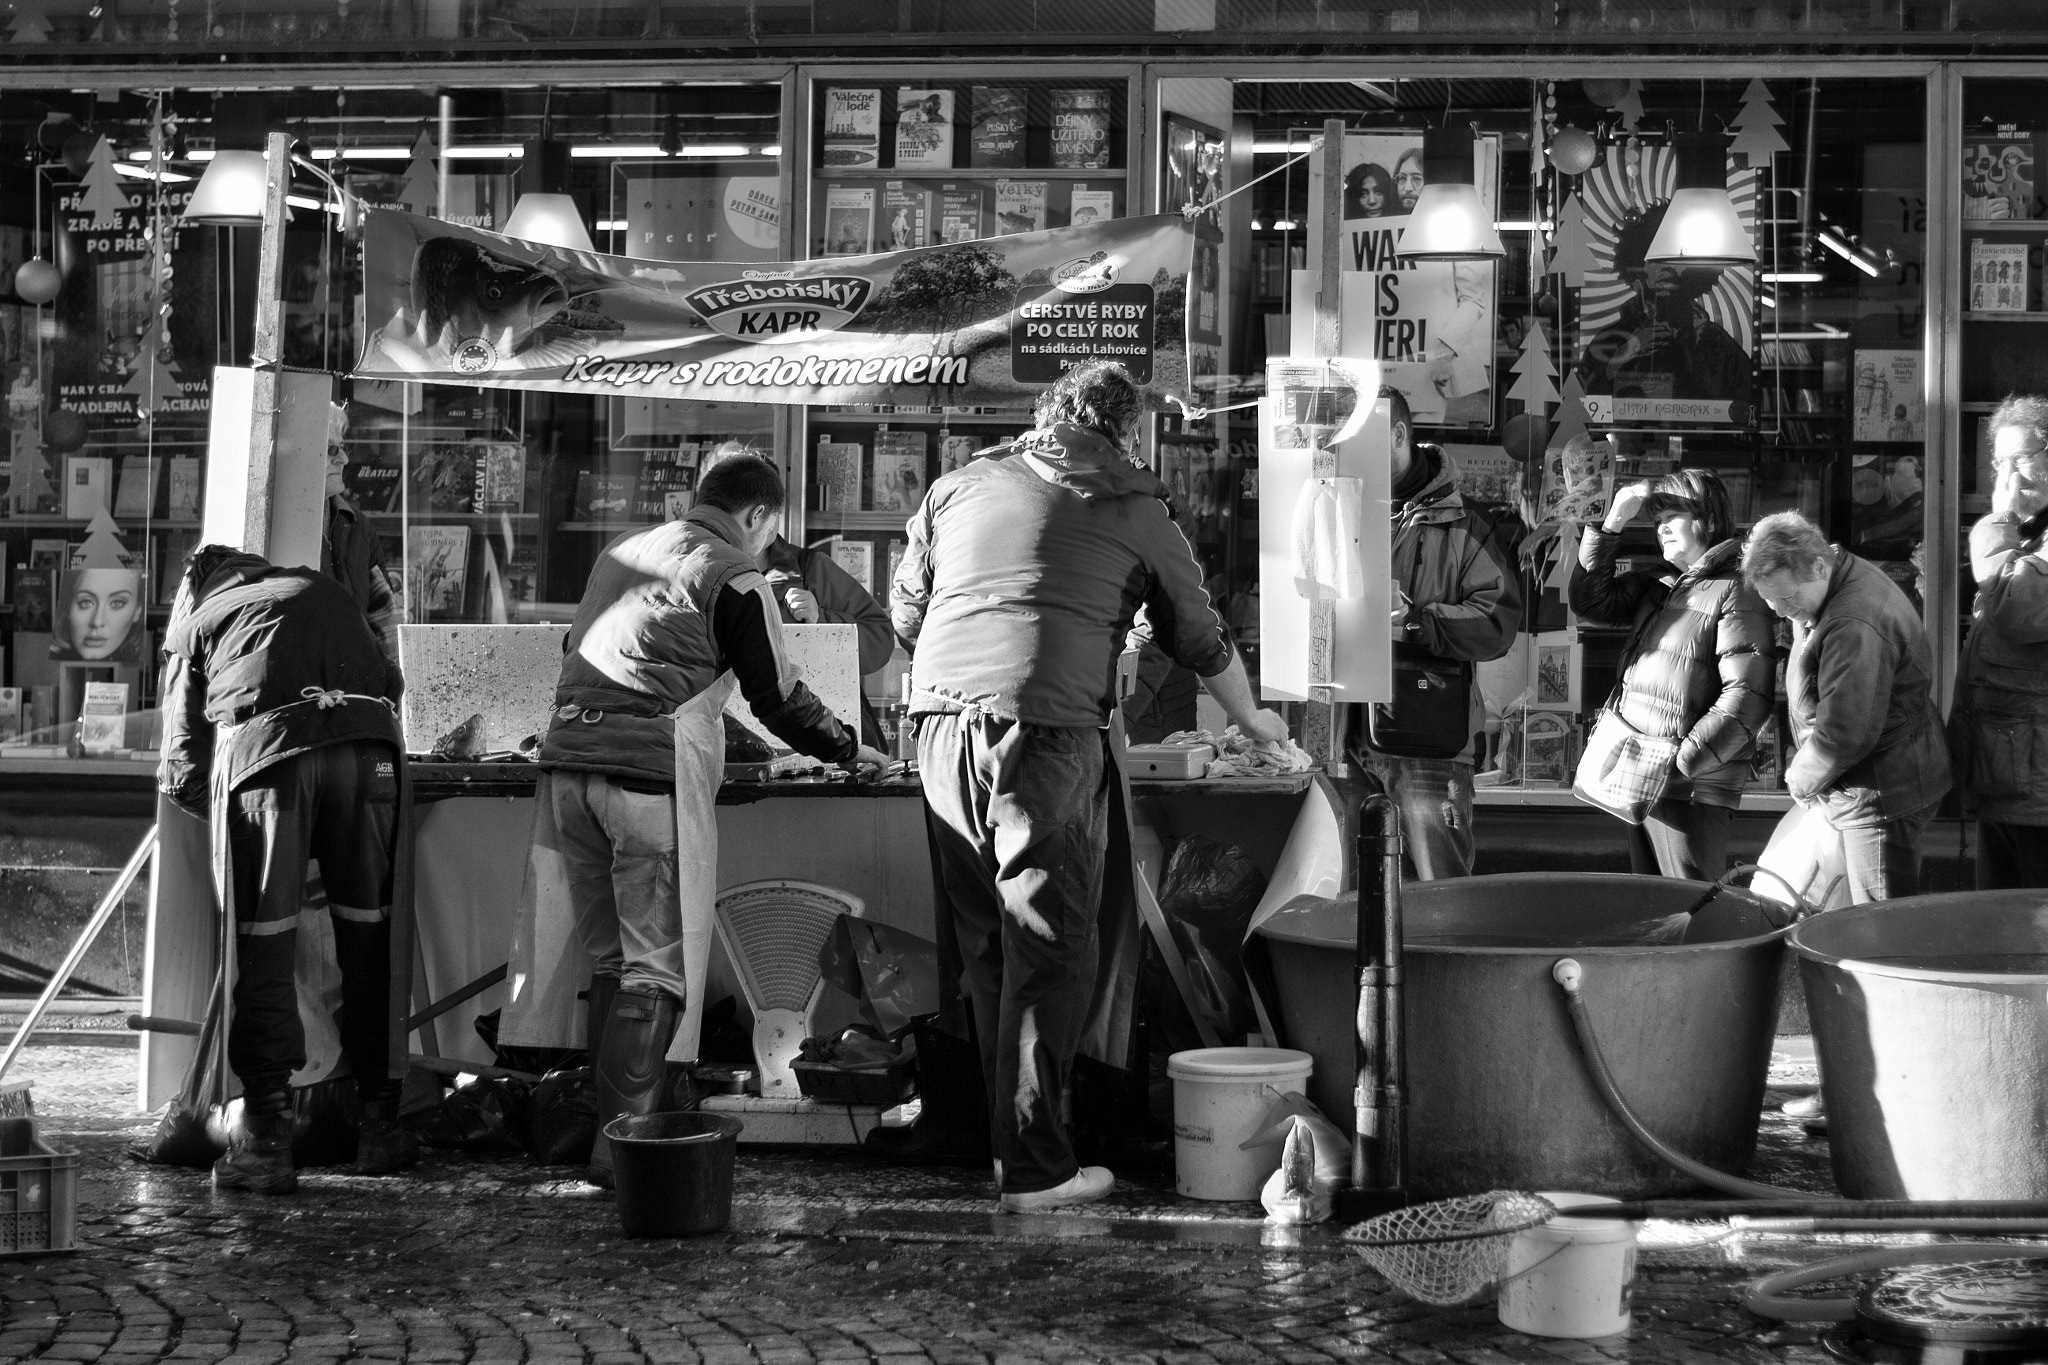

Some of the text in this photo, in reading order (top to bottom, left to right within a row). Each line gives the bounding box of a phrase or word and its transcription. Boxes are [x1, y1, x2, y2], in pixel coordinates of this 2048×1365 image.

[832, 91, 875, 102] Válečné
[846, 101, 871, 111] lodě
[148, 189, 193, 207] LÁSC
[997, 183, 1045, 198] Velký
[86, 238, 111, 253] PO
[693, 279, 861, 310] Třeboňský
[1019, 301, 1148, 320] ČERSTVÉ RYBY
[737, 310, 821, 335] KAPR
[1026, 320, 1140, 339] PO CELÝ ROK
[1021, 342, 1147, 356] na sádkách Lahovice
[564, 353, 970, 387] Kapr s rodokmenem
[60, 384, 95, 396] MARY
[1654, 402, 1711, 418] HENDRIX
[357, 469, 399, 478] BEATLES
